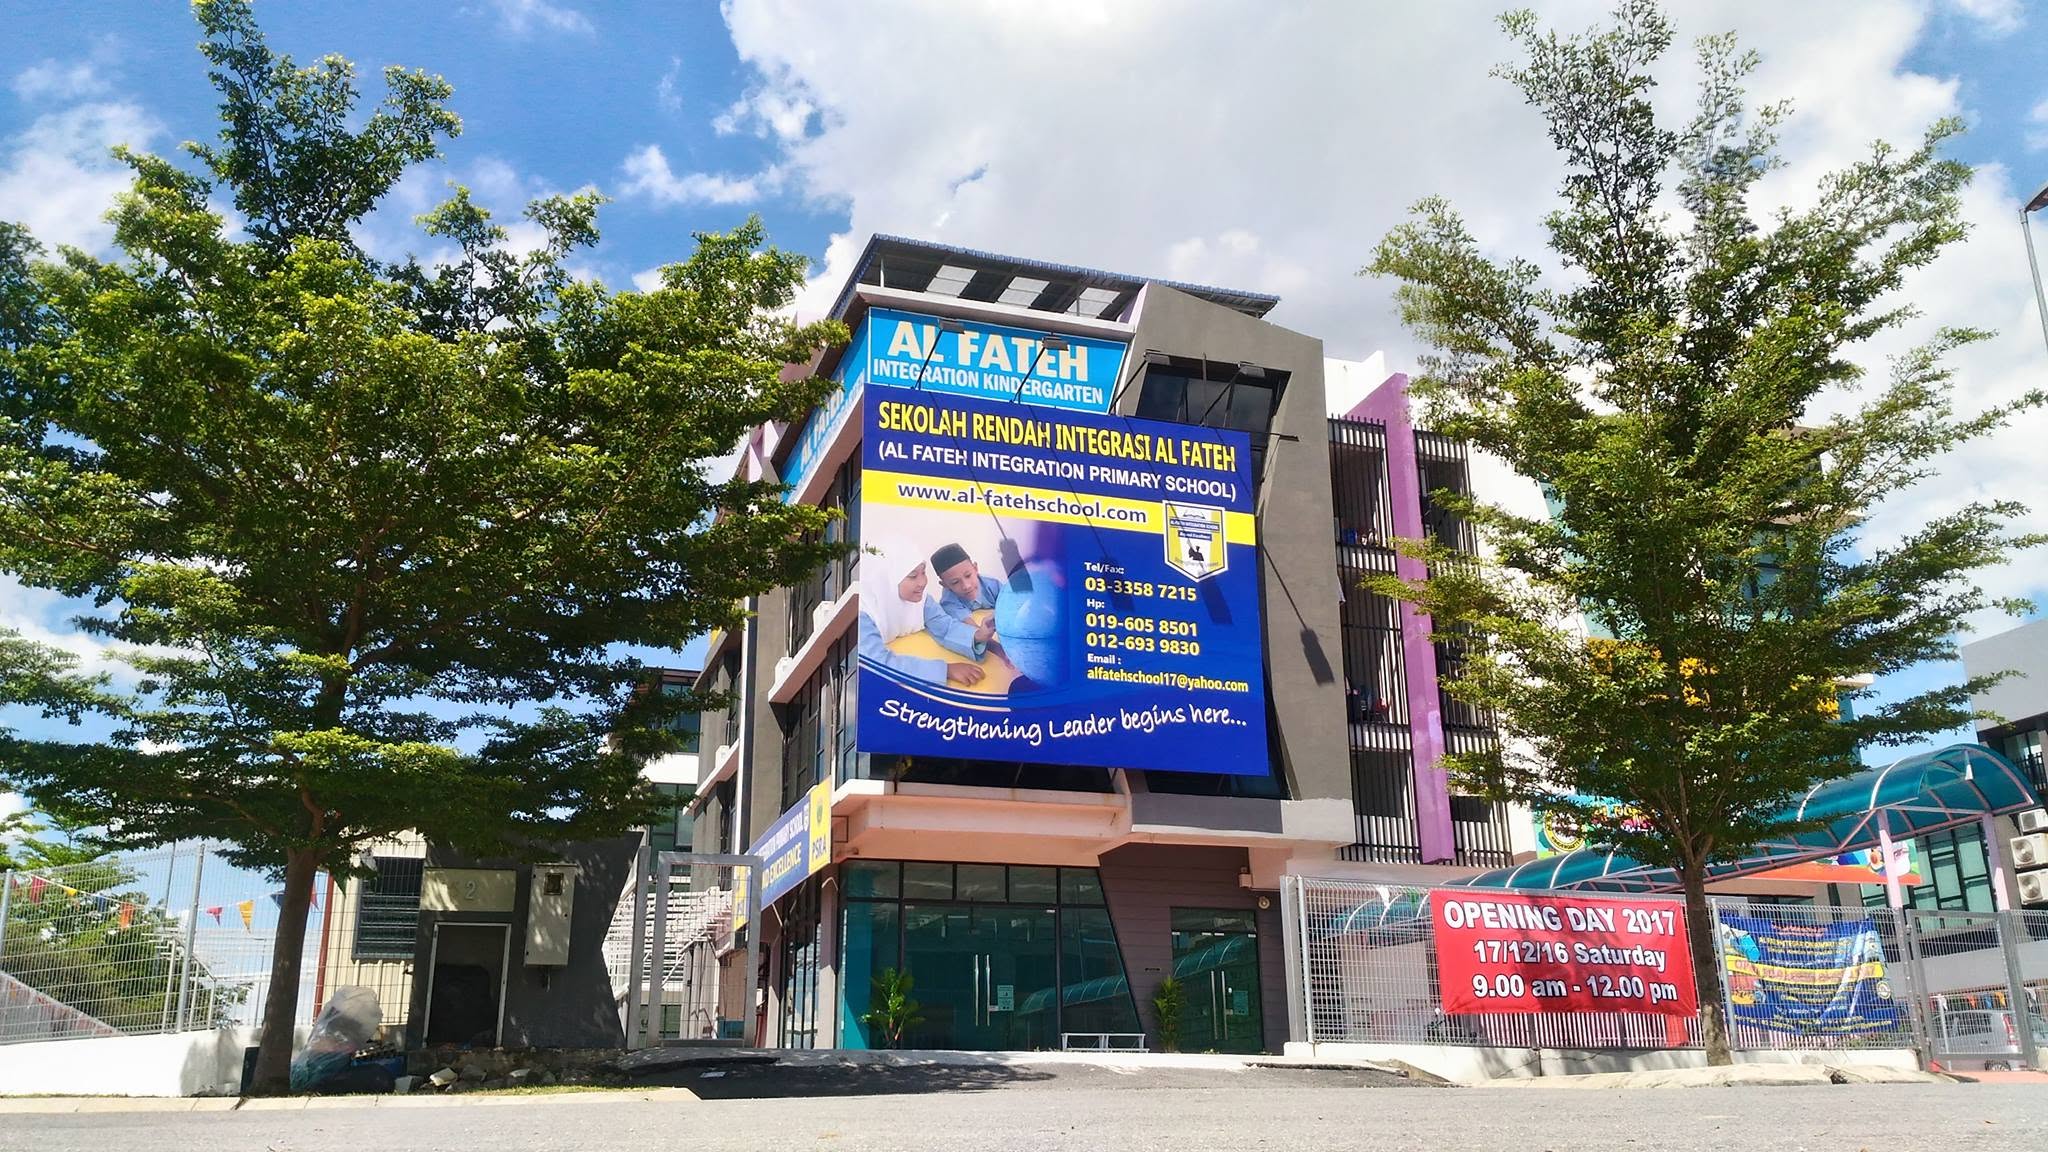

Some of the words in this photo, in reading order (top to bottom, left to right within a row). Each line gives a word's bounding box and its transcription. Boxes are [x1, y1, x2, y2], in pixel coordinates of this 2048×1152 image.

[887, 321, 944, 363] AL
[957, 331, 1089, 382] FATEH
[873, 358, 979, 389] INTEGRATION
[983, 375, 1103, 405] KINDERGARTEN
[878, 401, 967, 438] SEKOLAH
[972, 413, 1052, 449] RENDAH
[1055, 423, 1151, 462] INTEGRASI
[1155, 436, 1178, 465] AL
[1181, 439, 1236, 473] FATEH
[878, 440, 908, 461] (AL
[912, 445, 968, 466] FATEH
[972, 451, 1085, 481] INTEGRATION
[1089, 465, 1162, 489] PRIMARY
[1165, 475, 1237, 503] SCHOOL)
[898, 484, 1147, 523] www.al-fatehschool.com
[1084, 562, 1125, 575] Tel/Fax:
[1085, 577, 1154, 597] 03-3358
[1157, 584, 1197, 602] 7215
[1086, 598, 1105, 610] Hp:
[1085, 613, 1155, 633] 019-605
[1158, 620, 1198, 637] 8501
[1086, 632, 1156, 652] 012-693
[1159, 639, 1200, 656] 9830
[1087, 653, 1116, 665] Email
[1086, 666, 1249, 693] alfatehschool17@yahoo.com
[878, 699, 1042, 747] Strengthening
[1048, 713, 1117, 738] Leader
[1120, 703, 1186, 734] begins
[1188, 703, 1247, 727] here...
[465, 880, 476, 900] 2
[1443, 900, 1563, 931] OPENING
[1564, 906, 1616, 933] DAY
[1621, 908, 1675, 936] 2017
[1473, 940, 1570, 964] 17/12/16
[1573, 942, 1666, 973] Saturday
[1472, 973, 1525, 998] 9.00
[1531, 979, 1568, 998] am
[1586, 975, 1645, 998] 12.00
[1648, 982, 1678, 1005] pm
